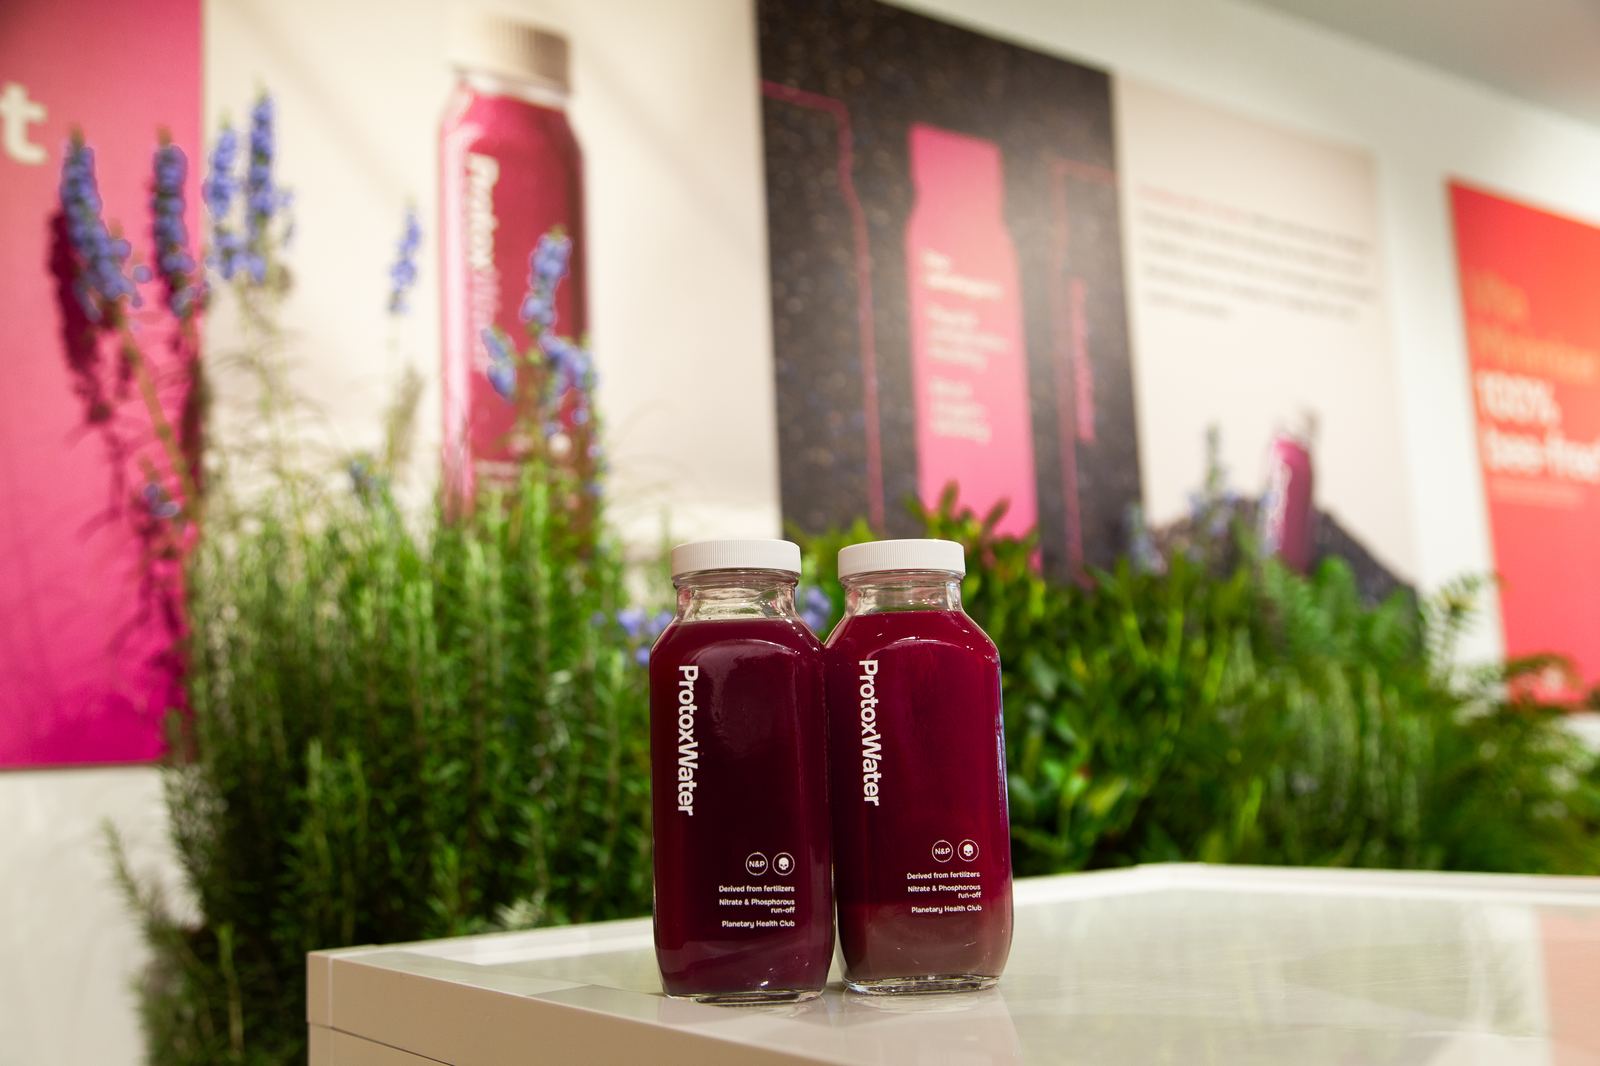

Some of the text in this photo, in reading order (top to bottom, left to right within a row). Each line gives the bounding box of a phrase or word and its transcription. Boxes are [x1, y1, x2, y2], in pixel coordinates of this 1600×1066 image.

[858, 659, 882, 806] ProtoxWater
[678, 665, 699, 816] ProtoxWater
[934, 847, 951, 855] N&P
[748, 860, 766, 868] N&P
[906, 872, 932, 880] Derived
[950, 870, 981, 878] fertilizers
[718, 885, 795, 893] Derived from fertilizers
[907, 885, 931, 893] Nitrate
[938, 884, 981, 892] Phosphorous
[957, 891, 982, 899] run-off
[719, 898, 795, 907] Nitrate & Phosphorous
[770, 906, 796, 914] run-off
[911, 904, 983, 914] Planetary Health Club
[721, 920, 755, 929] Planetary
